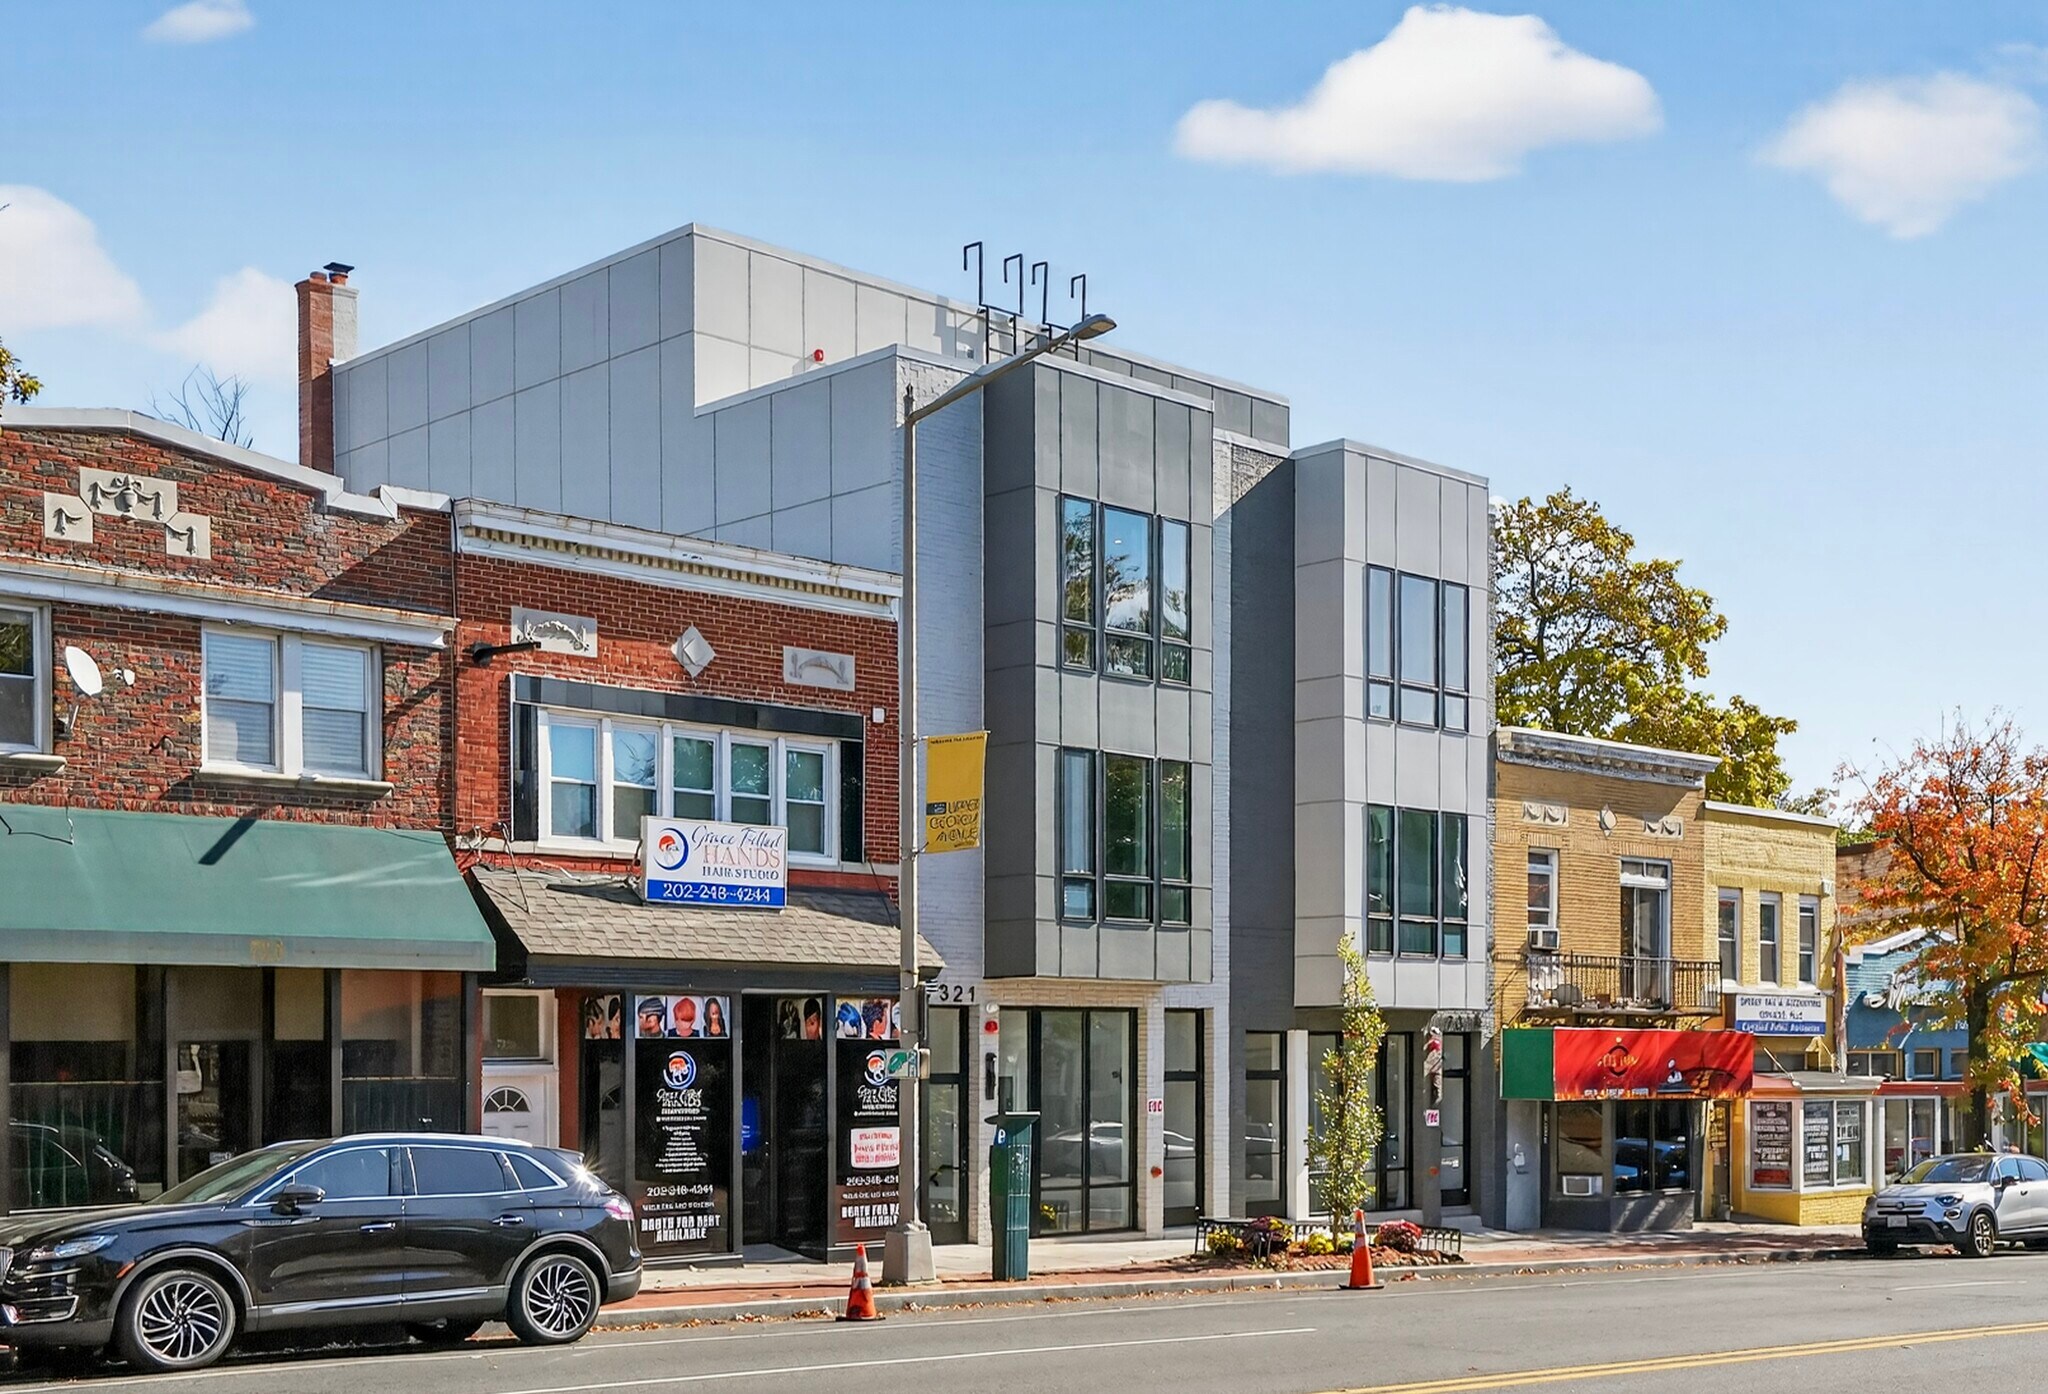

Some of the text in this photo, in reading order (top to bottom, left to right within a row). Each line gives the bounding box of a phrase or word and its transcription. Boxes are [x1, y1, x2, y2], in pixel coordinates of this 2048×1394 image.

[691, 825, 783, 850] Grace Filled
[703, 845, 781, 868] HANDS
[735, 868, 779, 880] STUDIO
